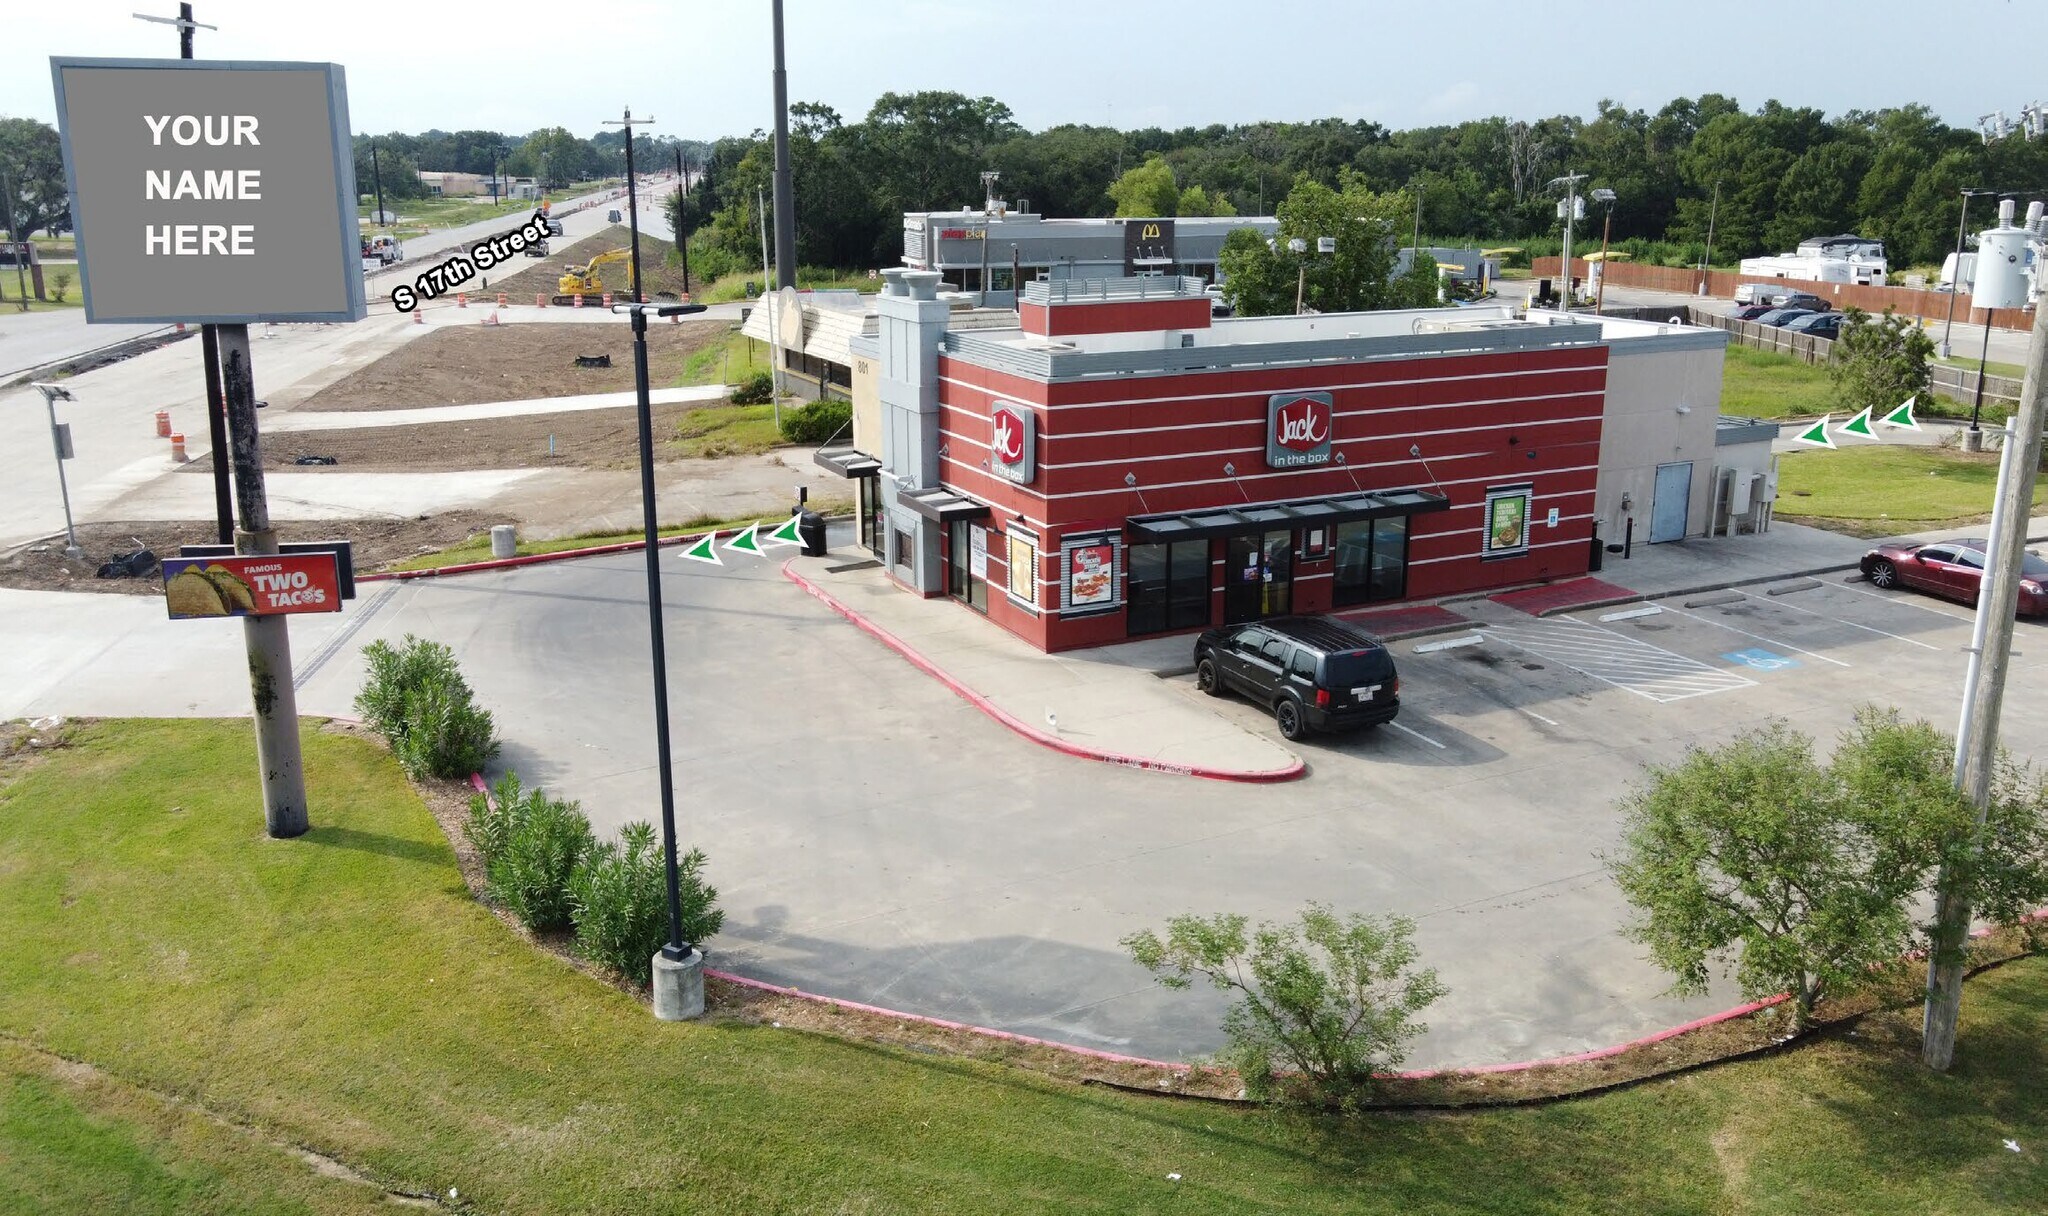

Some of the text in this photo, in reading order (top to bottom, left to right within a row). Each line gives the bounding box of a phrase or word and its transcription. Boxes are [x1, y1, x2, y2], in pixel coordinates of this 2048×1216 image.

[1278, 404, 1328, 444] Jack
[1274, 453, 1329, 465] in the box
[999, 463, 1010, 477] the
[1010, 467, 1024, 481] box
[244, 564, 282, 574] FAMOUS
[253, 571, 308, 592] TWO
[267, 587, 326, 608] TACOS
